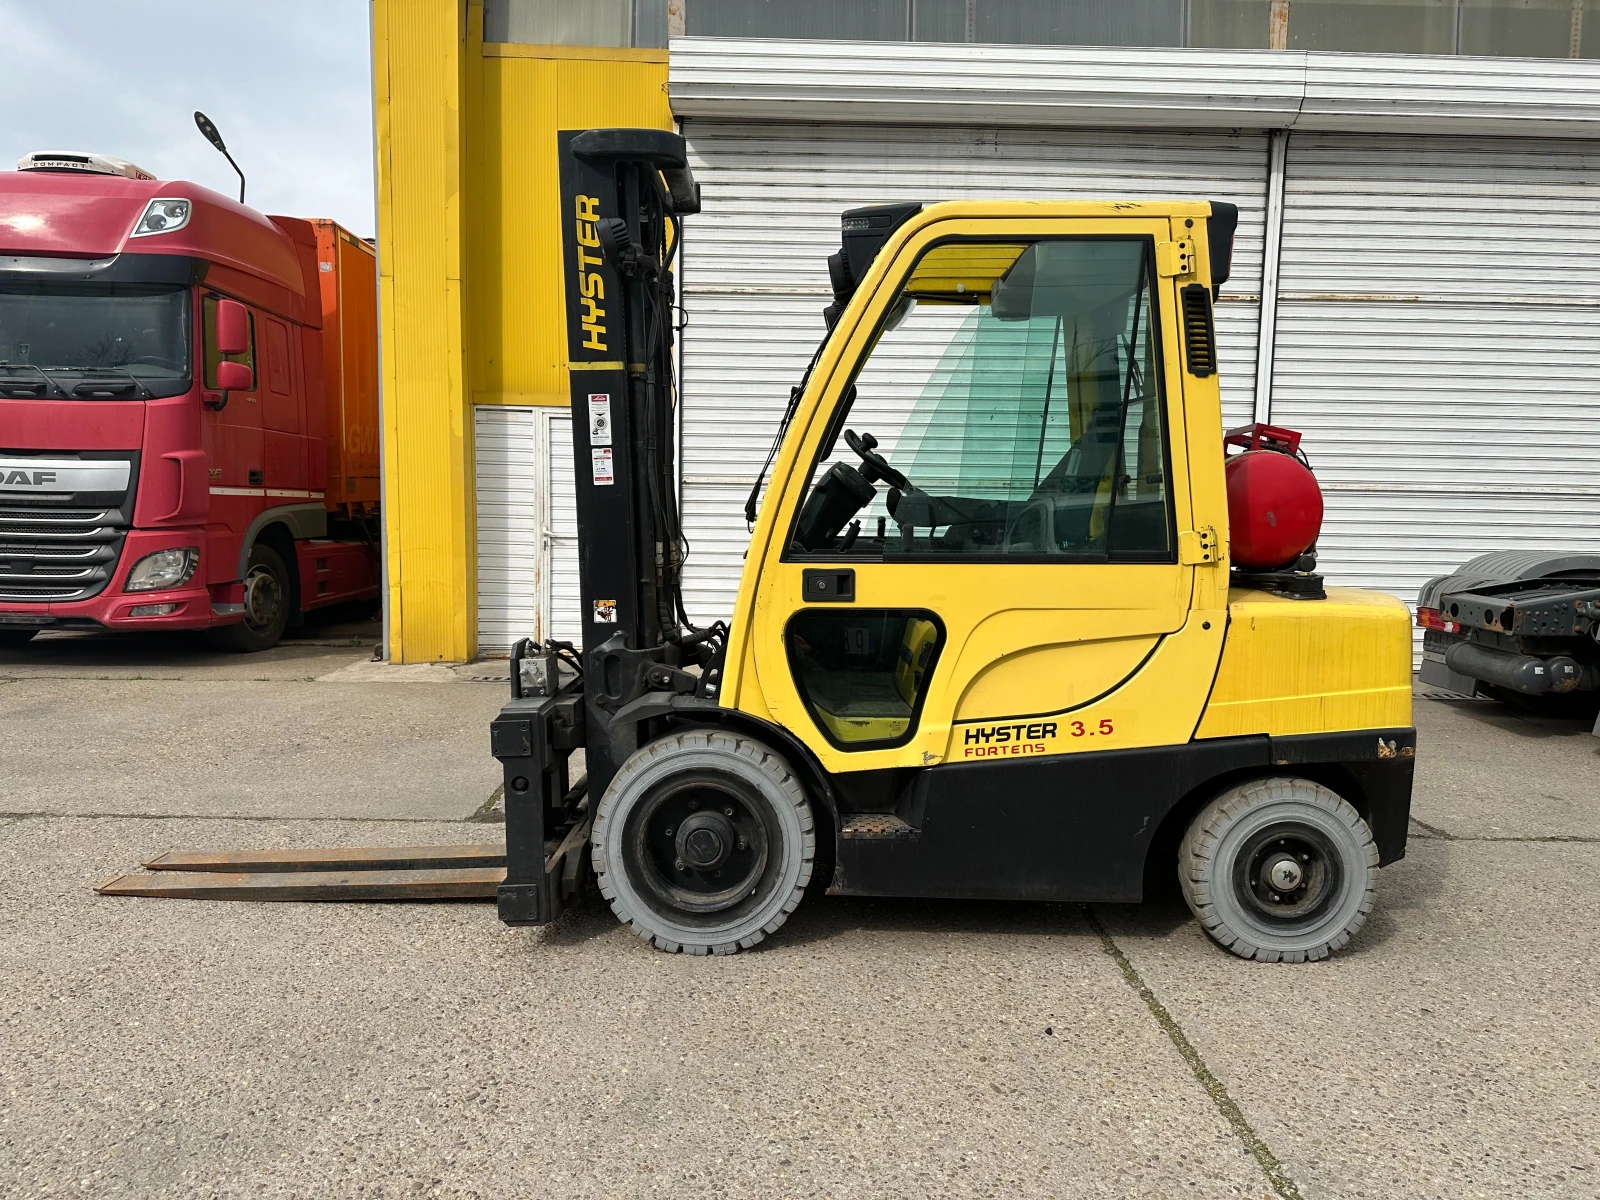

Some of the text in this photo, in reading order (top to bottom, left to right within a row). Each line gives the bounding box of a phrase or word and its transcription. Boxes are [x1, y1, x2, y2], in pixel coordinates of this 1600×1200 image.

[575, 194, 608, 352] HYSTER
[0, 470, 57, 486] AF
[964, 718, 1114, 745] HYSTER 3.5
[964, 743, 1046, 758] FORTENS
